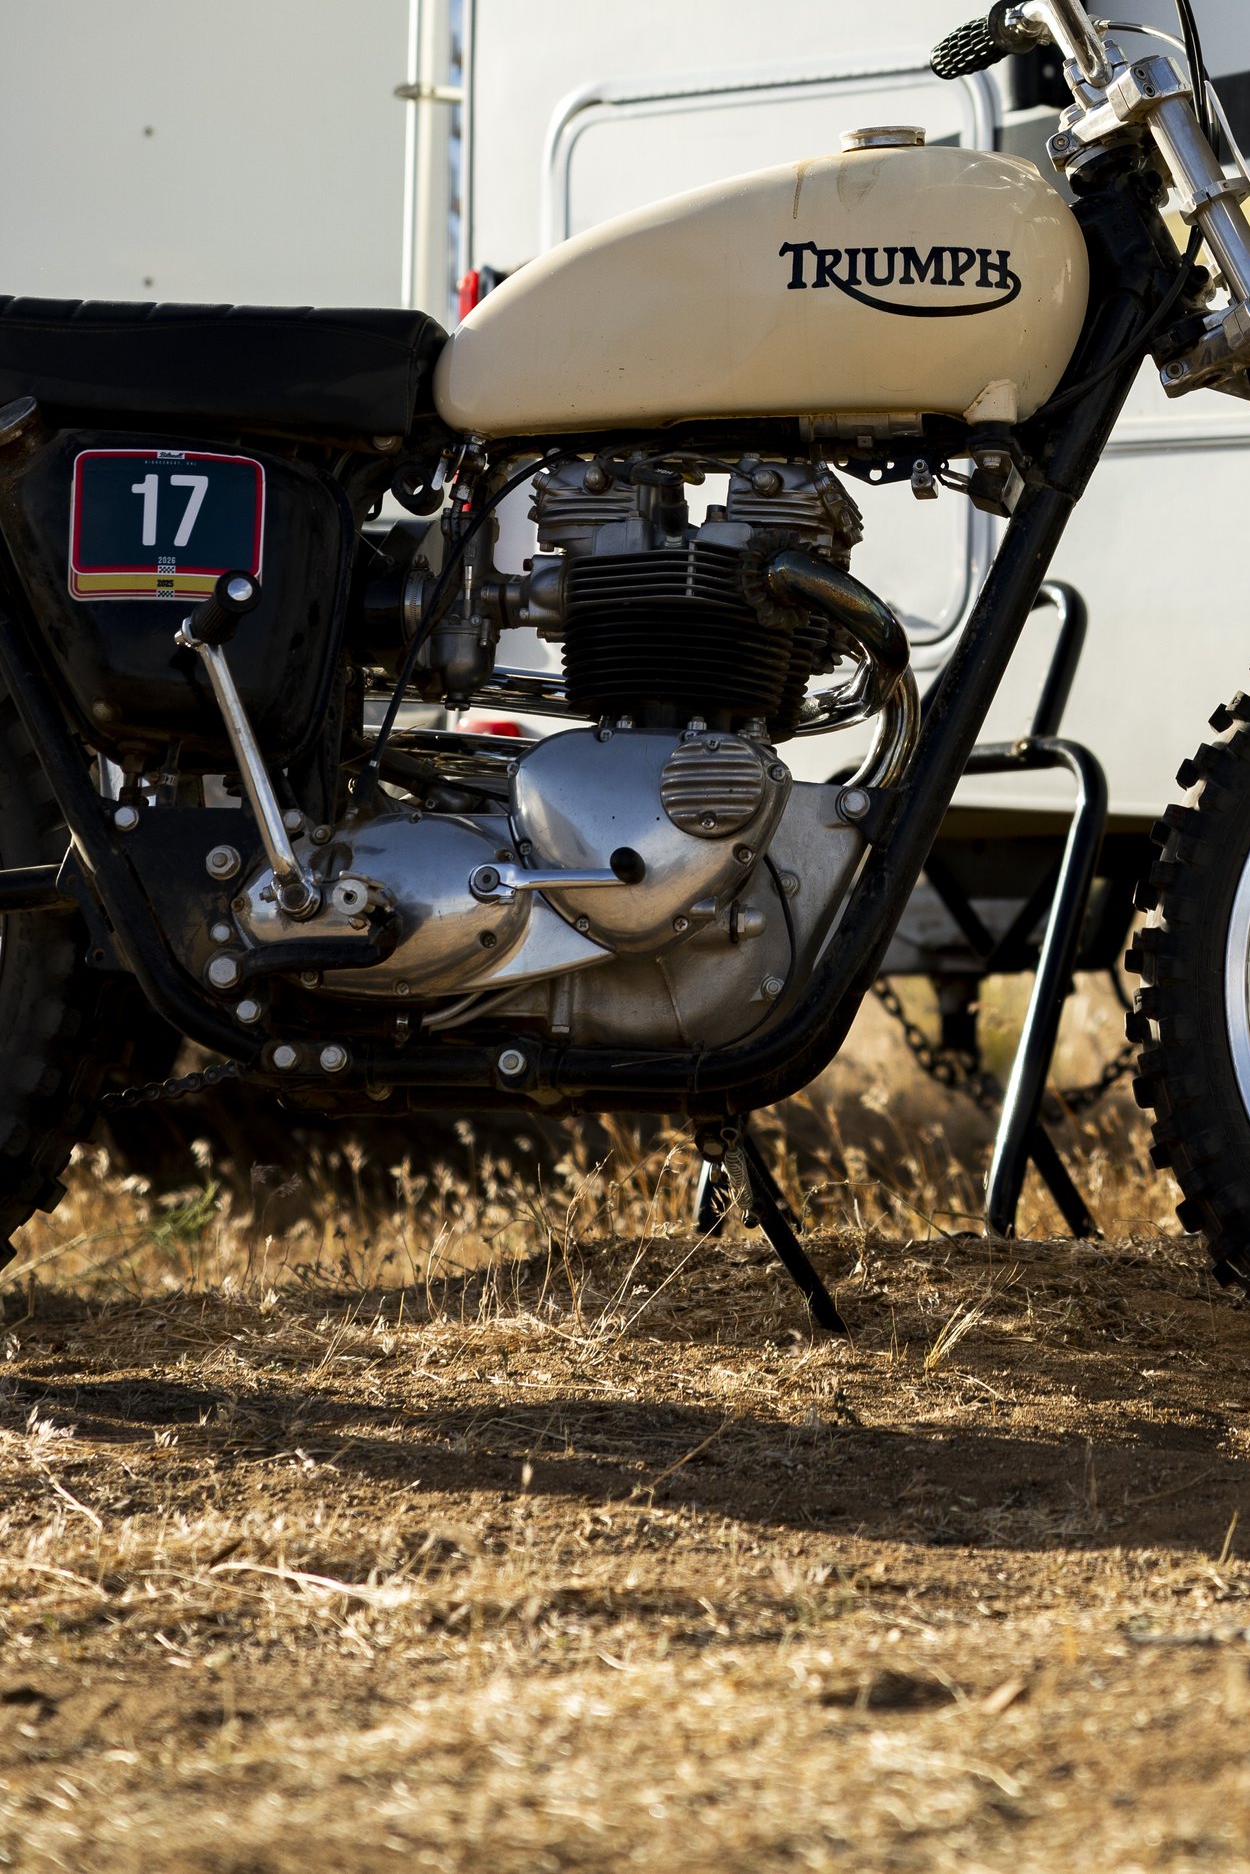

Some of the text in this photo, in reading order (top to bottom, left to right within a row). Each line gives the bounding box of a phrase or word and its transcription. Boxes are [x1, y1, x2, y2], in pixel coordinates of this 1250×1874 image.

[779, 241, 1021, 317] TRIUMPH
[131, 474, 209, 547] 17
[158, 556, 176, 564] 2026
